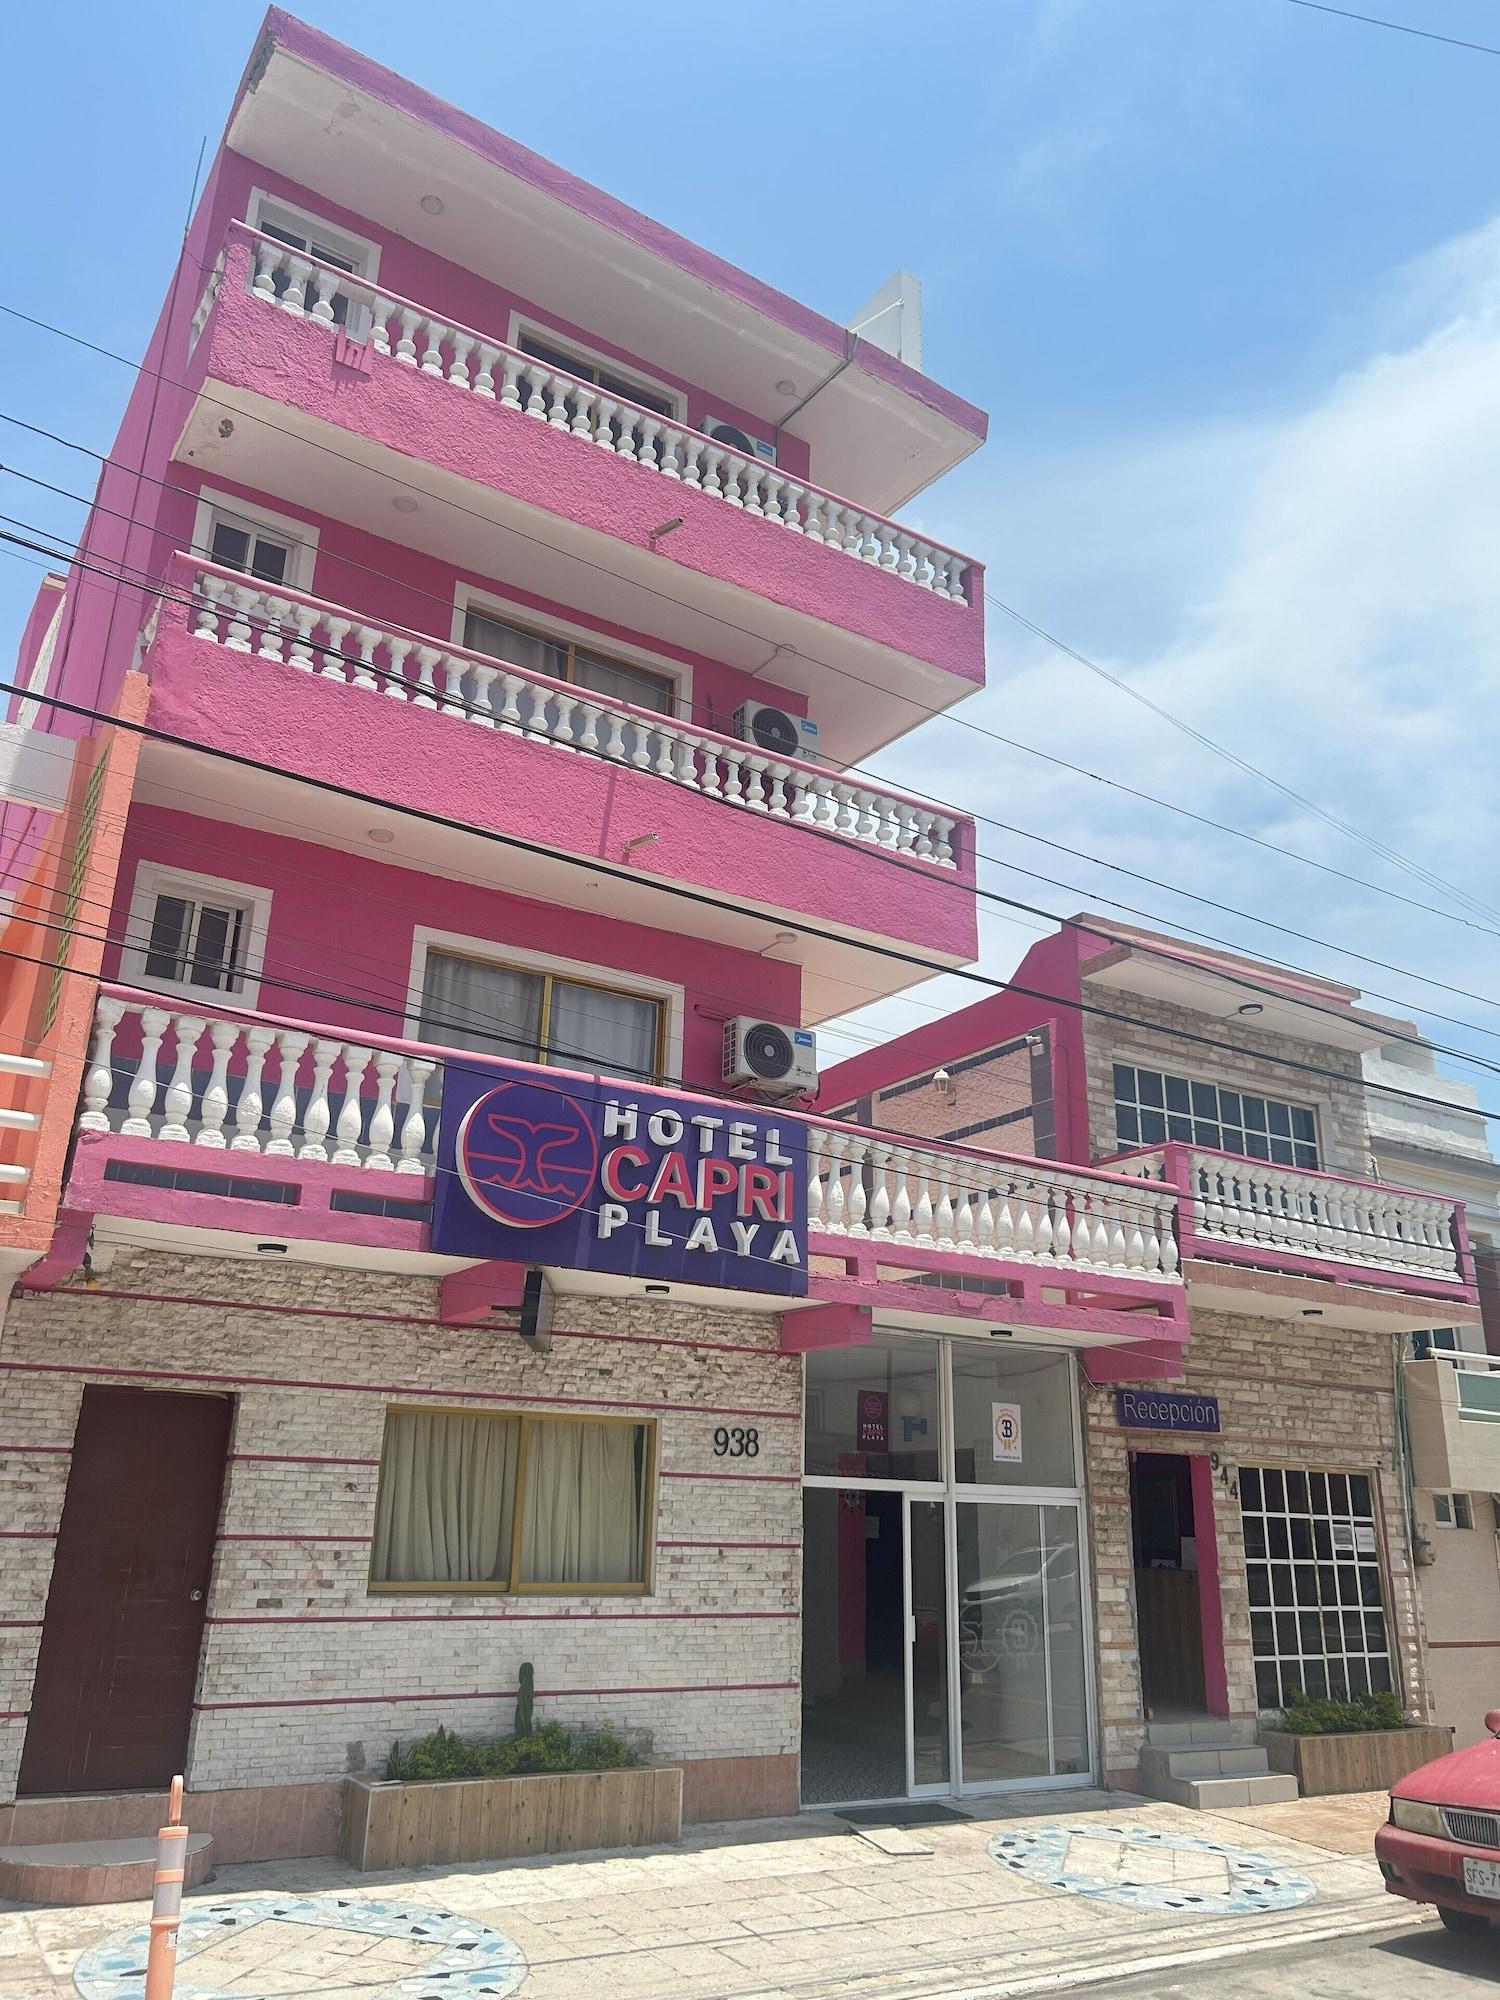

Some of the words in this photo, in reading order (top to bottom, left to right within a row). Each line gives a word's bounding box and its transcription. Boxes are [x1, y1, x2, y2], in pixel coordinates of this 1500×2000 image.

[603, 1100, 794, 1166] HOTEL
[601, 1145, 794, 1223] CAPRI
[598, 1203, 801, 1264] PLAYA
[863, 1423, 883, 1431] HOTEL
[1123, 1393, 1217, 1427] Recepción
[714, 1427, 760, 1457] 938
[1466, 1867, 1500, 1888] SFS-7
